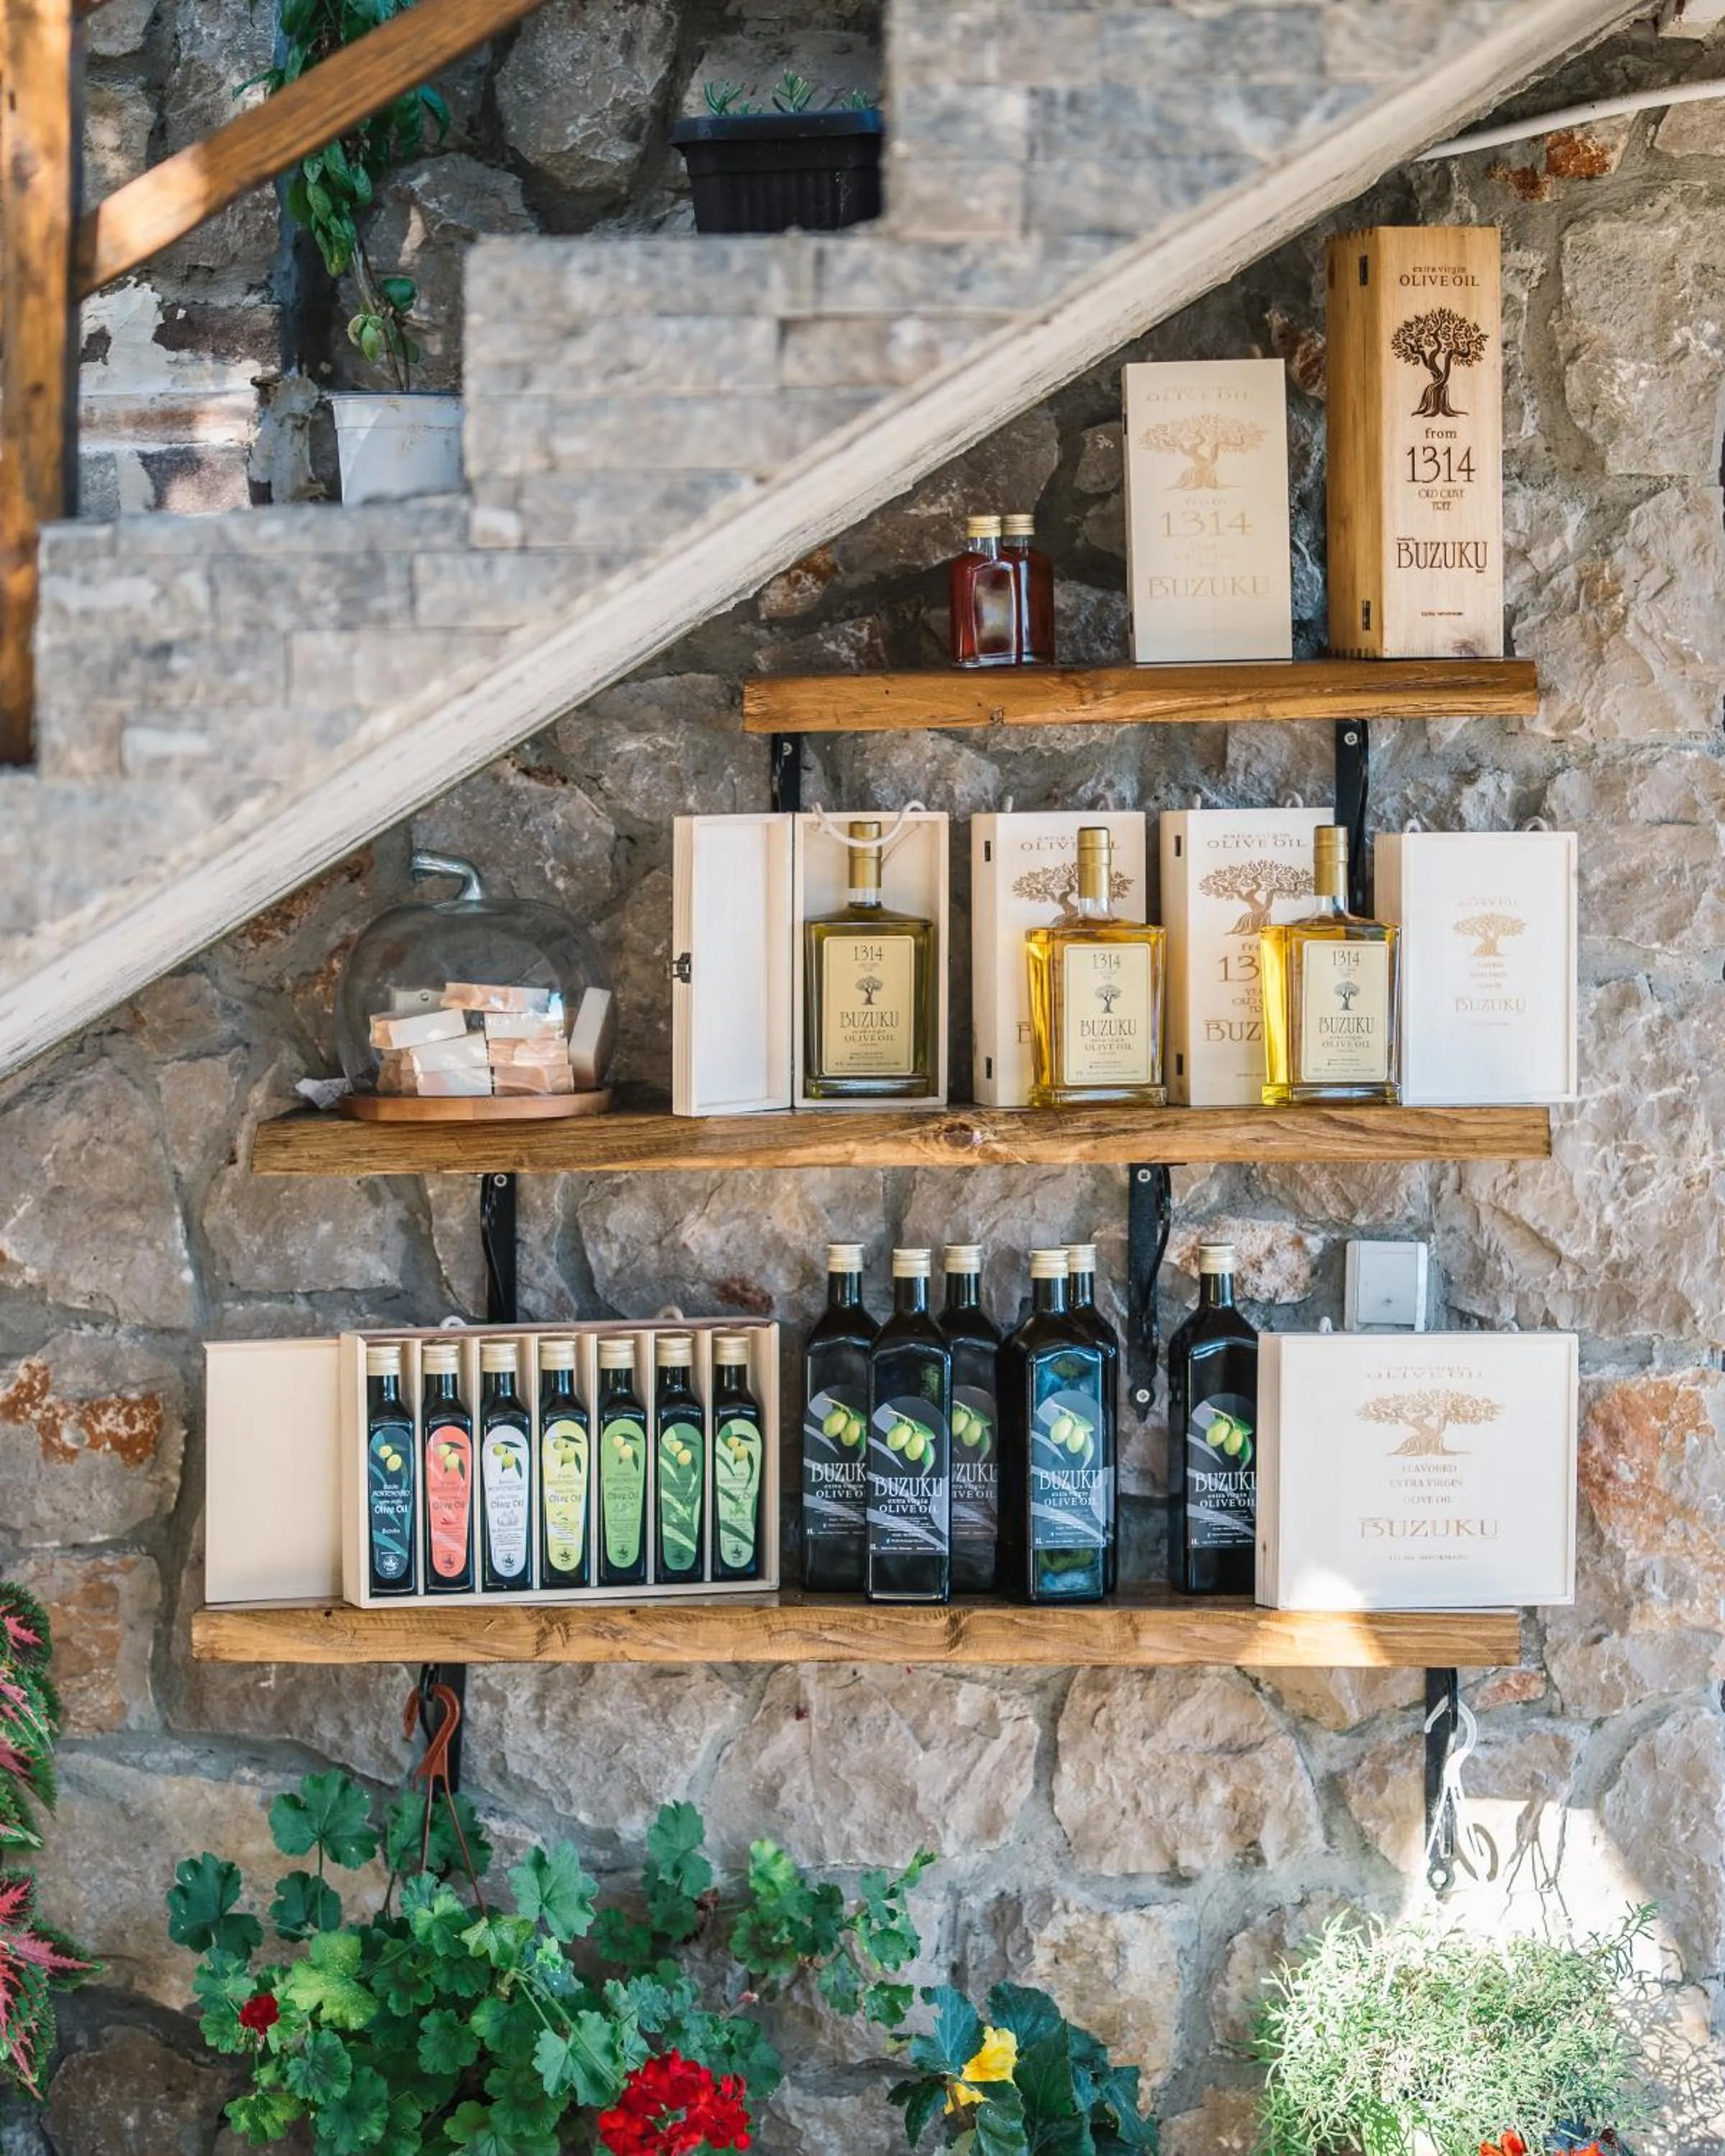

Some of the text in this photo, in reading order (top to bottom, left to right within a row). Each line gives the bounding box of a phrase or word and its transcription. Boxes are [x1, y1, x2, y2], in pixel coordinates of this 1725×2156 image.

[1399, 274, 1480, 287] OLIVE OIL
[1425, 427, 1457, 439] from
[1406, 446, 1476, 484] 1314
[1161, 510, 1252, 538] 1314
[1397, 540, 1488, 569] BUZUKU
[1146, 575, 1271, 599] BUZUKU
[1207, 839, 1307, 849] OLIVE OIL
[853, 945, 885, 962] 1314
[1092, 953, 1121, 969] 1314
[1333, 949, 1360, 967] 1314
[1217, 955, 1260, 982] 13
[840, 1011, 899, 1028] BUZUKU
[1080, 1018, 1137, 1036] BUZUKU
[1318, 1017, 1375, 1034] BUZUKU
[1204, 1022, 1264, 1042] BUZ
[811, 1463, 867, 1483] BUZUK
[1039, 1470, 1103, 1490] BUZUKU
[816, 1490, 852, 1498] OLIVE
[873, 1477, 942, 1497] BUZUKU
[954, 1490, 997, 1499] IVE OIL
[396, 1504, 408, 1514] Oil
[919, 1505, 940, 1514] OIL
[1044, 1497, 1098, 1507] OLIVE OIL
[1200, 1498, 1236, 1508] OLIVE
[1358, 1518, 1499, 1539] BUZUKU
